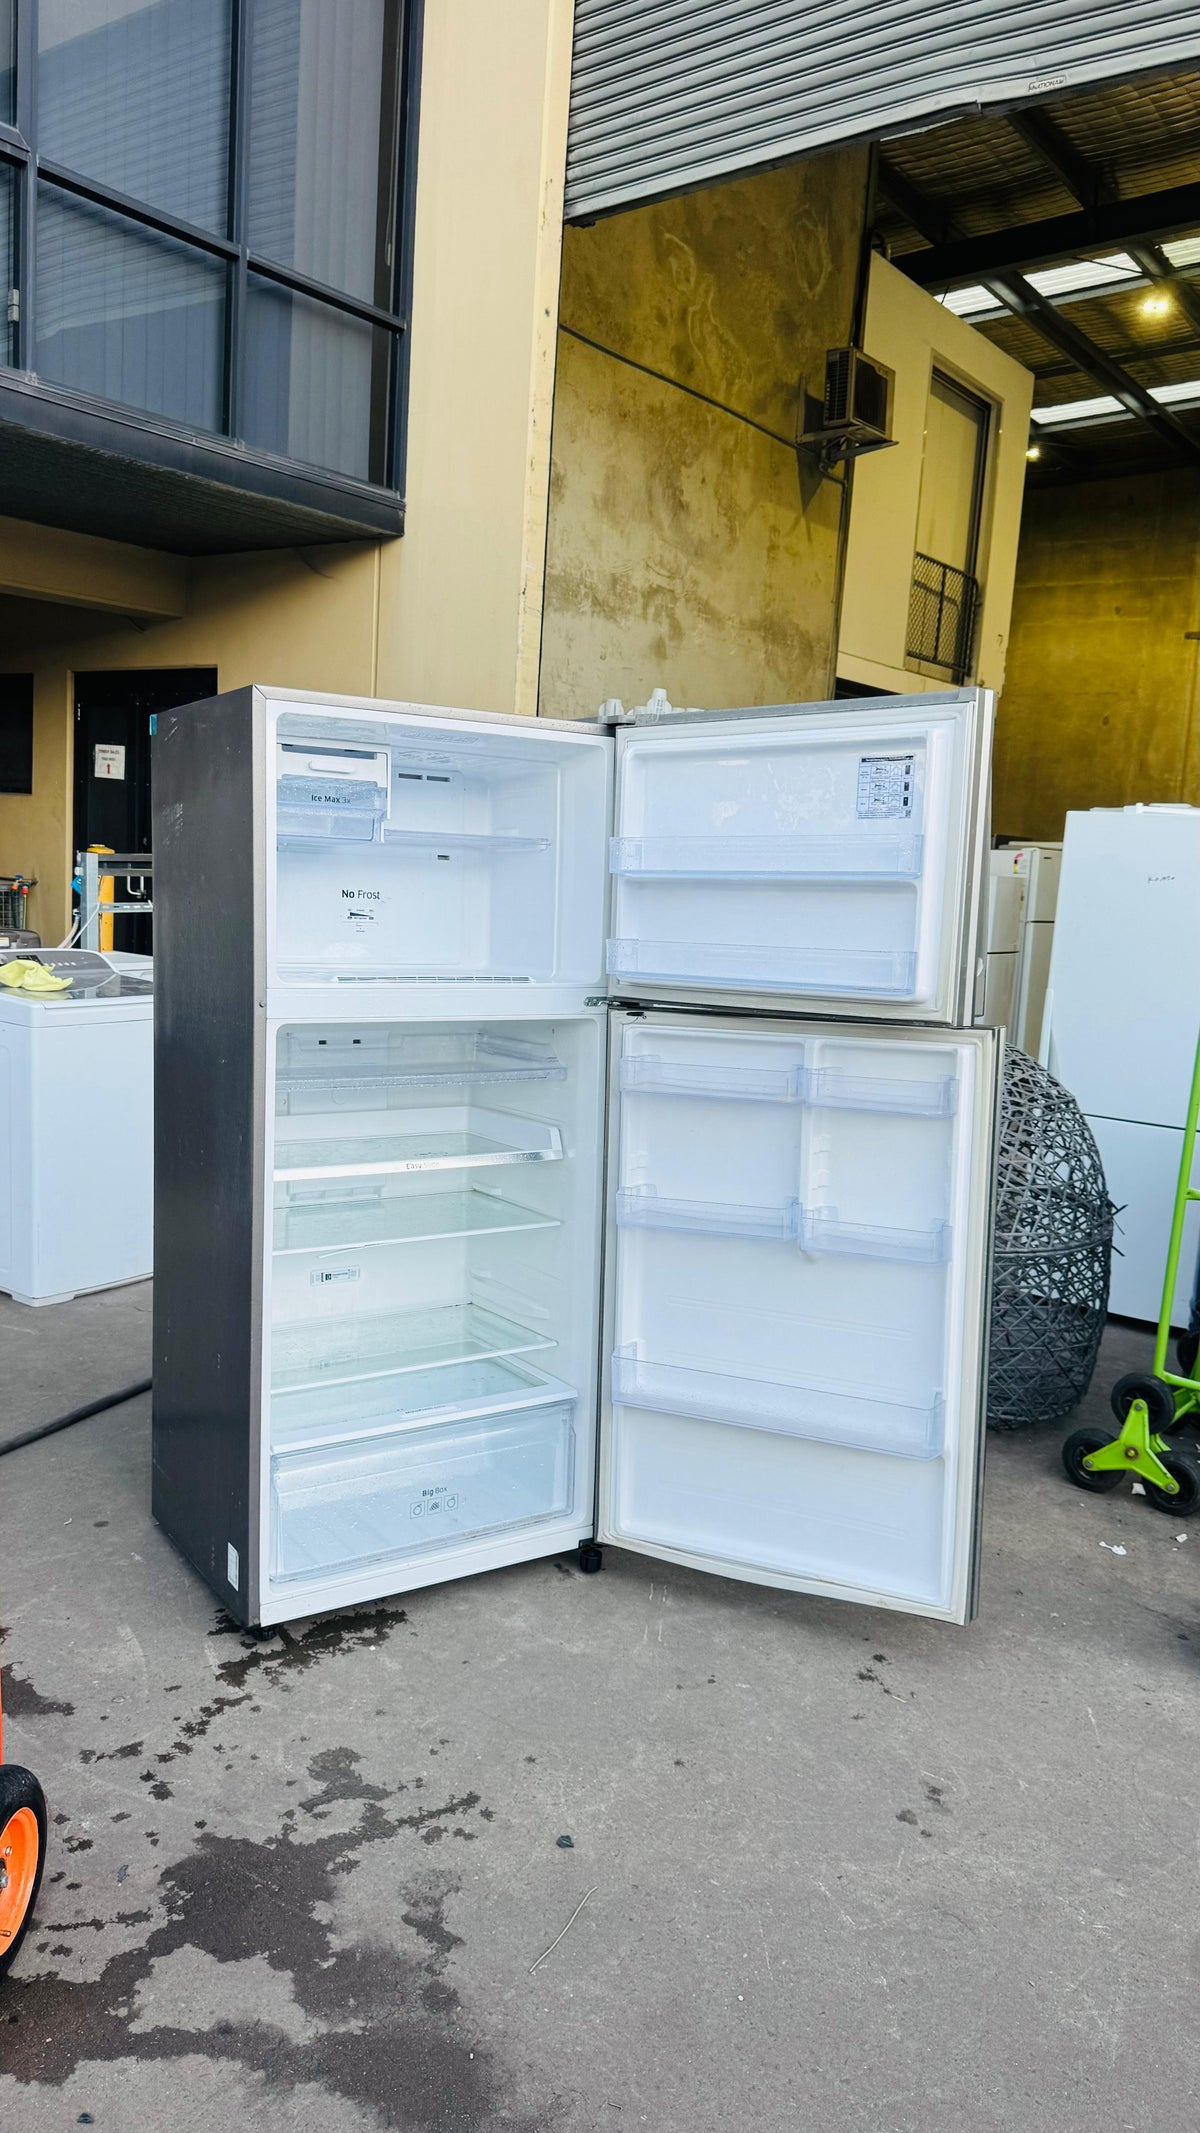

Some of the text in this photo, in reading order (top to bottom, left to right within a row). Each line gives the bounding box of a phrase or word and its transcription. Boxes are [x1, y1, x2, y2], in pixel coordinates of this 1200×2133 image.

[311, 794, 323, 802] Ice
[324, 795, 340, 803] Max
[341, 889, 381, 900] No Frost
[422, 1489, 434, 1497] Big
